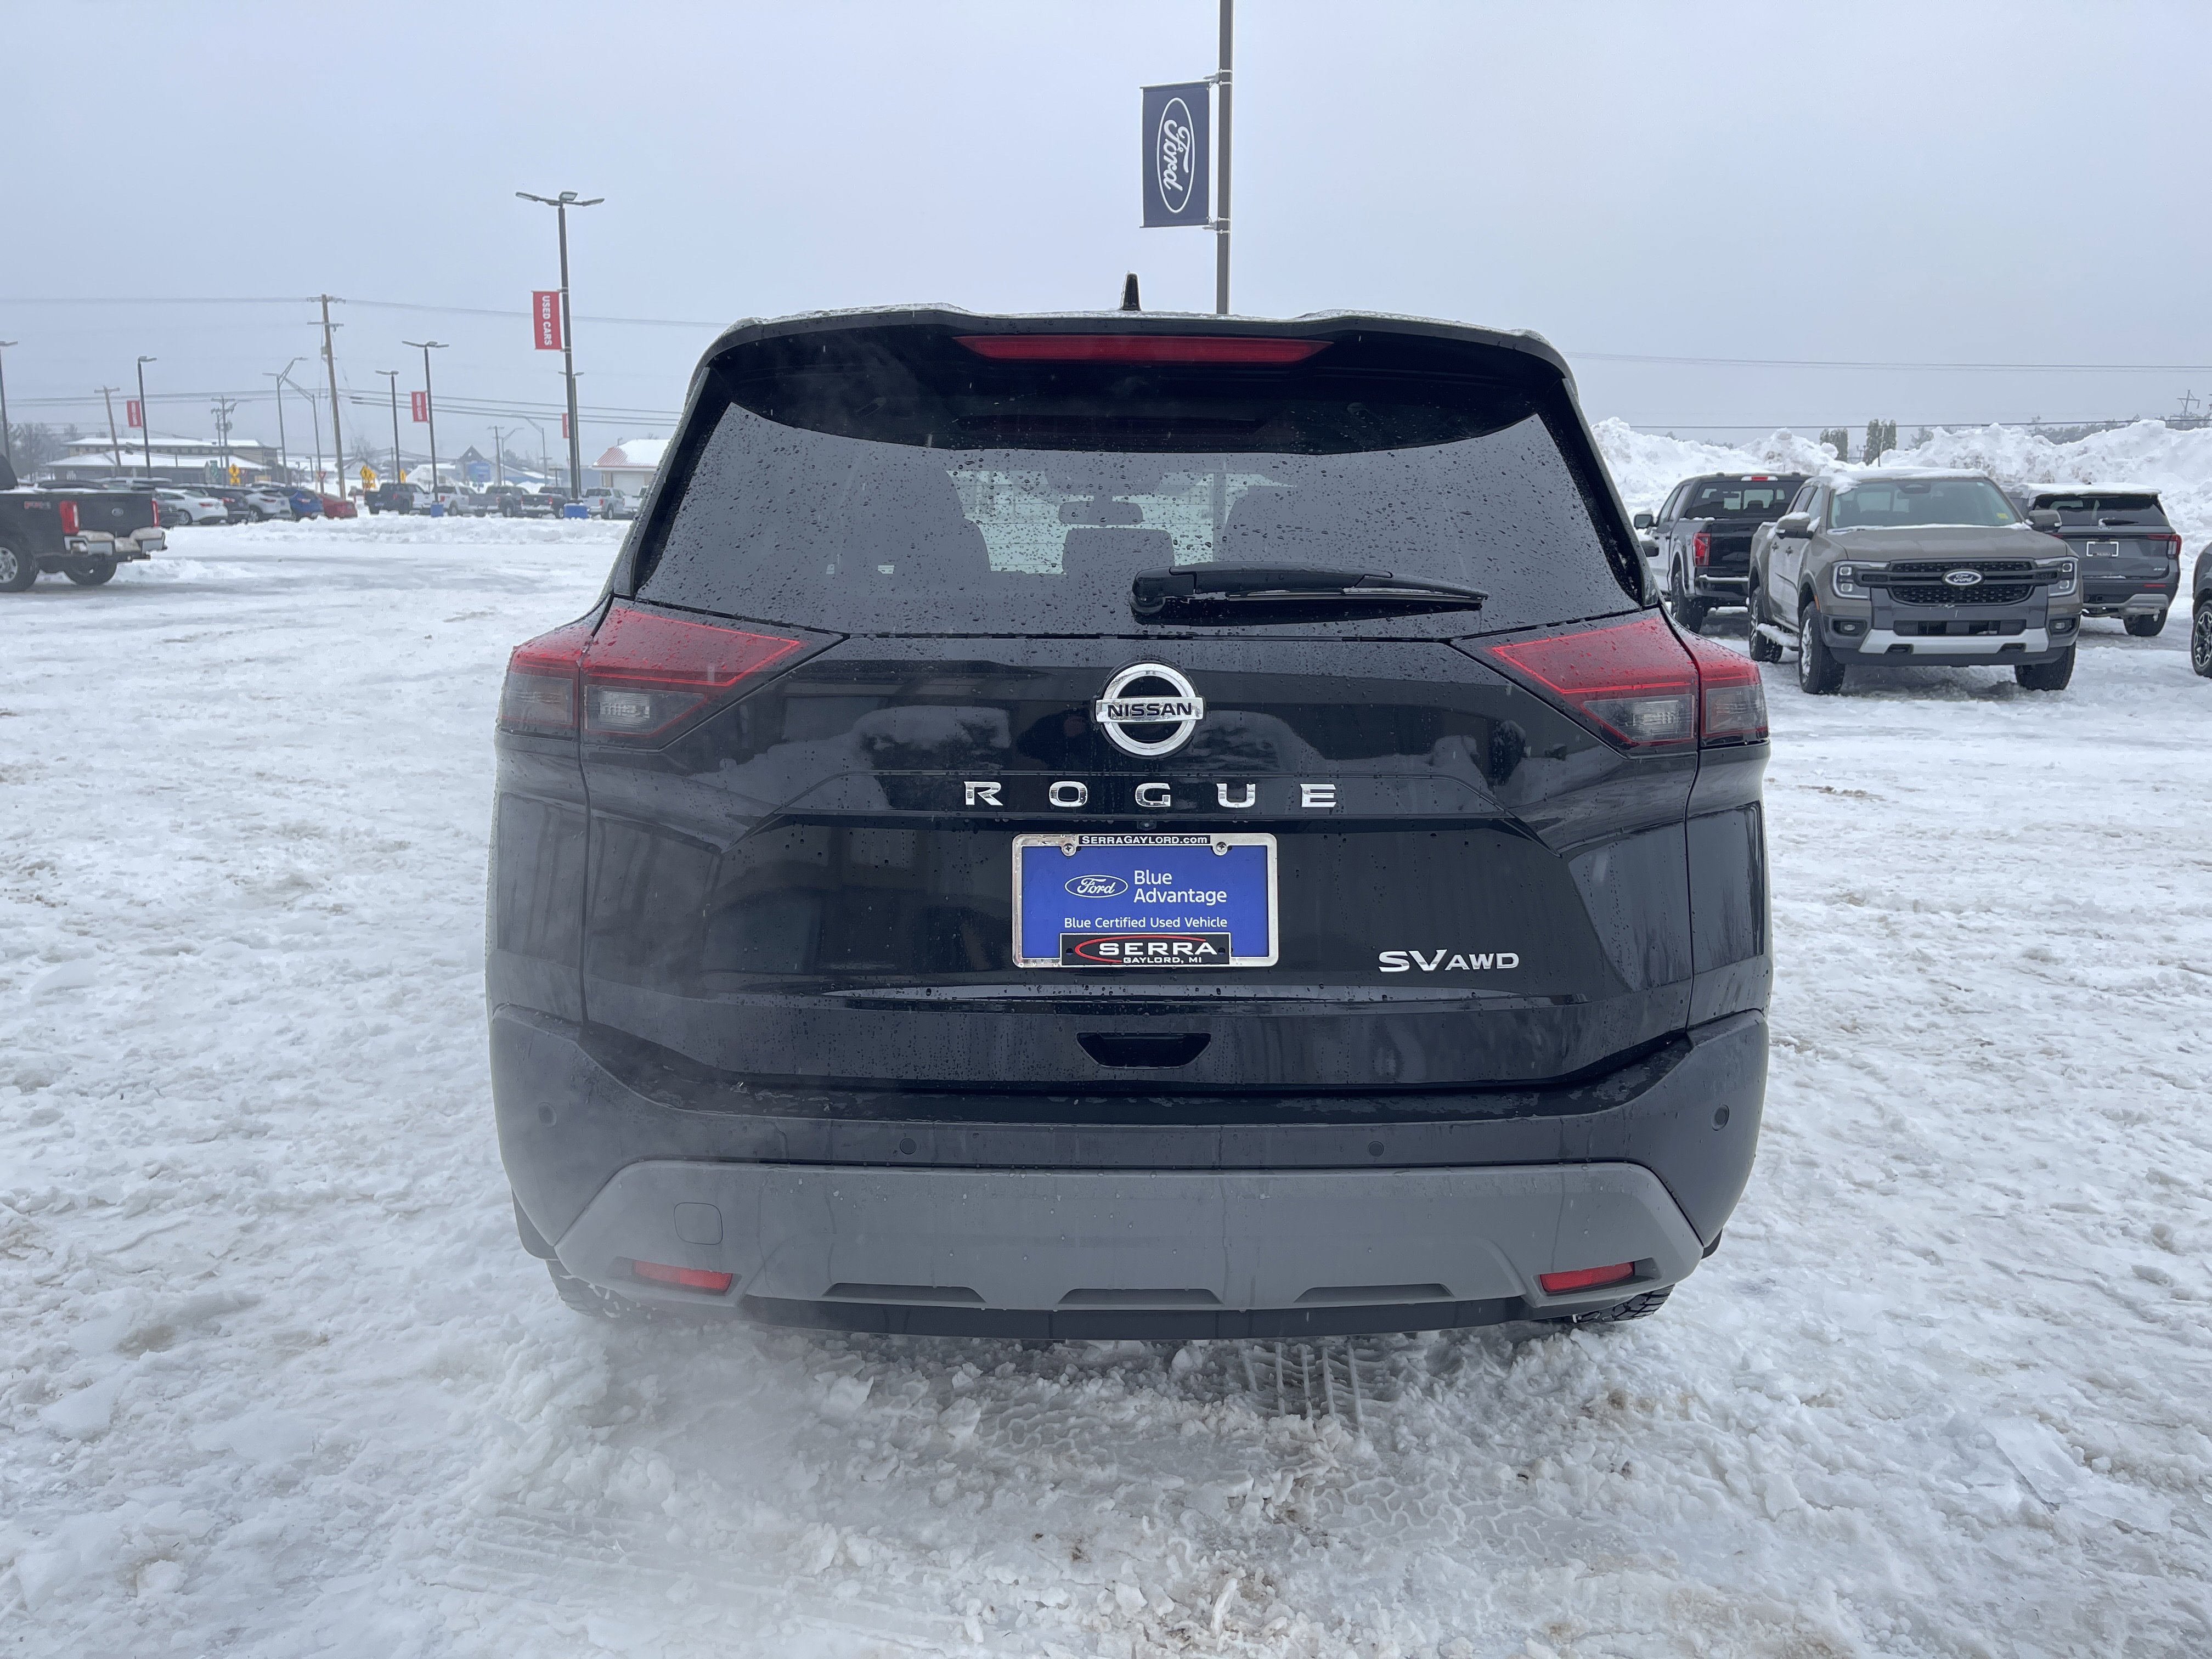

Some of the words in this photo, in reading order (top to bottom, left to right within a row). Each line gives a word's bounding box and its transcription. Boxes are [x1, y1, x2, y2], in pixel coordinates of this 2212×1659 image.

[1163, 119, 1190, 191] Ford
[542, 295, 551, 319] USED
[543, 321, 553, 346] CARS
[1108, 702, 1192, 718] NISSAN
[963, 781, 1337, 808] ROGUE
[1076, 877, 1116, 894] Ford
[1133, 870, 1172, 885] Blue
[1133, 888, 1227, 906] Advantage
[1064, 917, 1091, 928] Blue
[1094, 917, 1146, 928] Certified
[1150, 917, 1181, 928] Used
[1184, 917, 1227, 928] Vehicle
[1098, 942, 1218, 956] SERRA
[1378, 949, 1448, 972] SV
[1444, 952, 1520, 971] AWD
